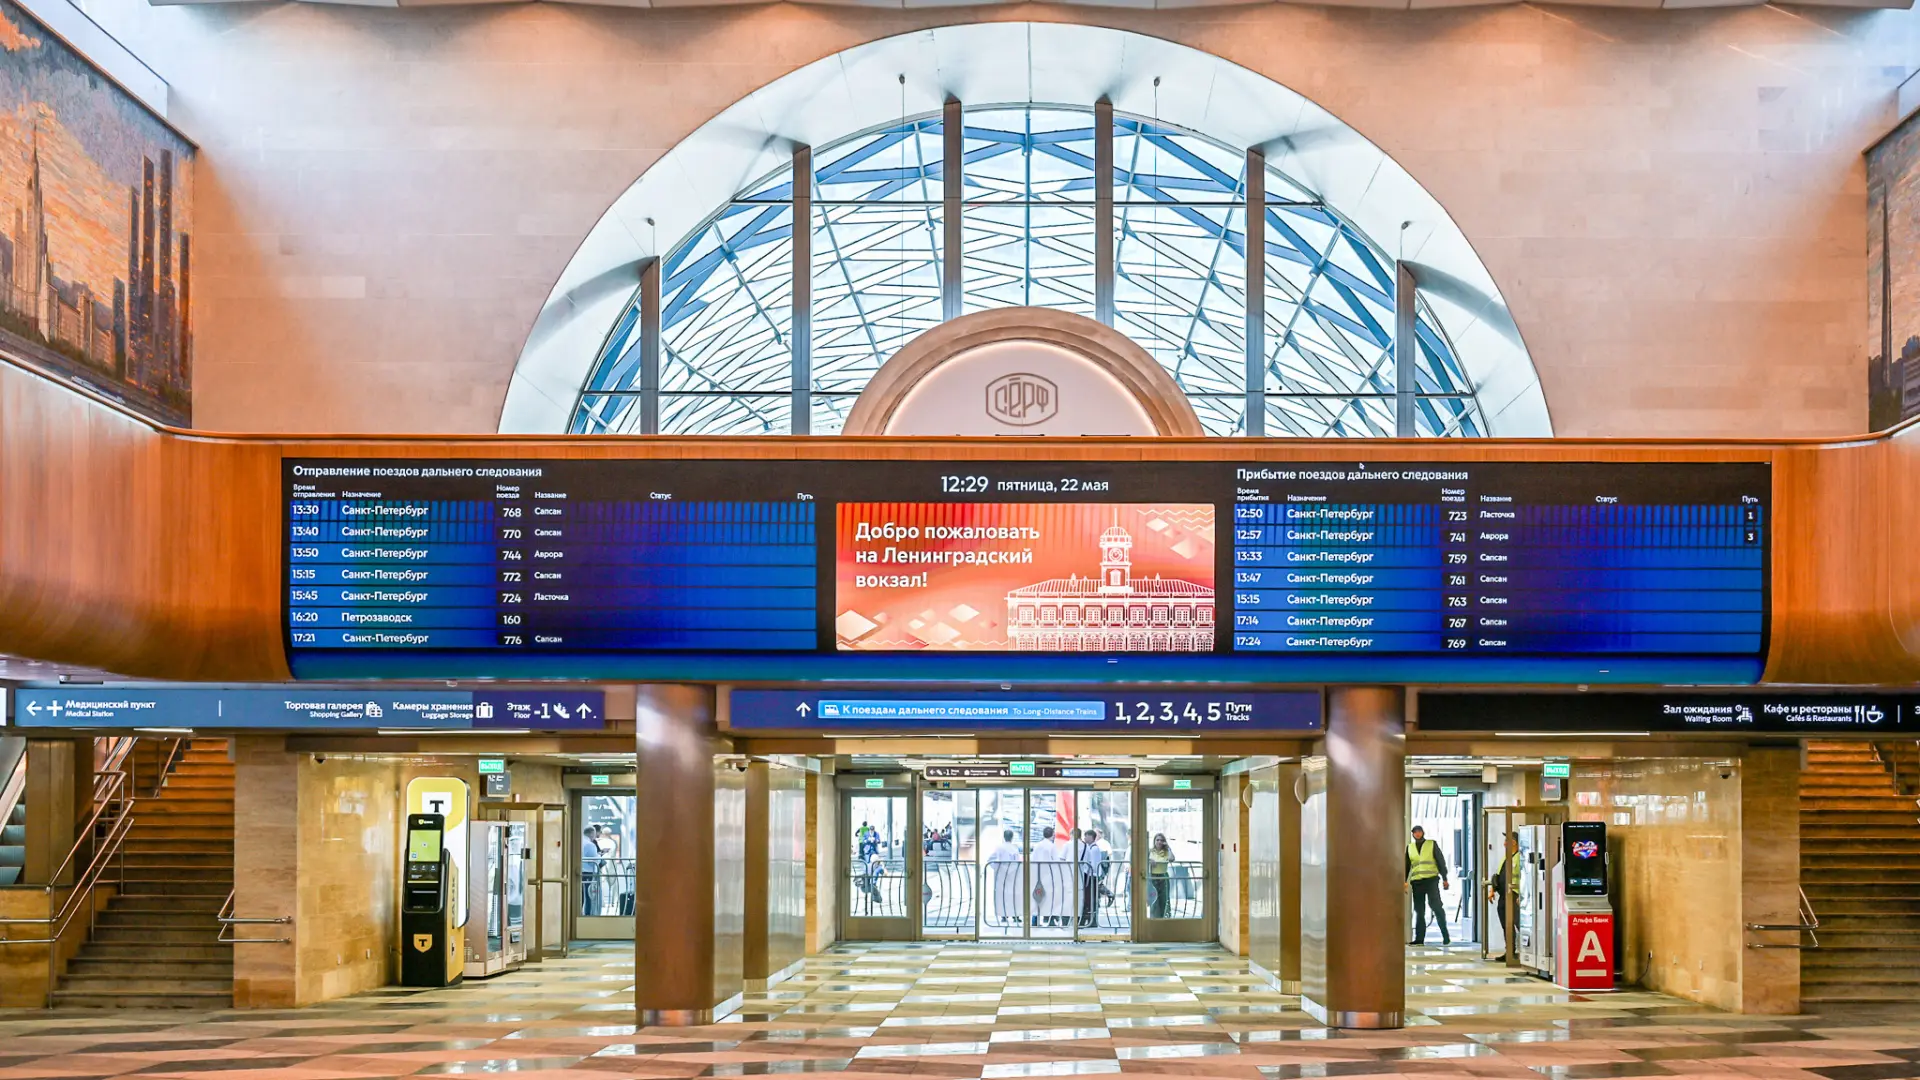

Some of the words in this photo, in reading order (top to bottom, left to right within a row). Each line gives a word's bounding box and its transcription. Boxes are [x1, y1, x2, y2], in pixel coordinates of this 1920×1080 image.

[293, 466, 371, 477] Отправление
[373, 467, 420, 477] поездов
[421, 467, 473, 477] дальнего
[475, 468, 542, 477] следования
[1237, 469, 1296, 481] Прибытие
[1299, 470, 1345, 481] поездов
[1347, 470, 1400, 481] дальнего
[1402, 471, 1468, 481] следования
[941, 476, 988, 493] 12:29
[998, 479, 1057, 493] пятница,
[1061, 479, 1078, 491] 22
[1082, 480, 1109, 491] мая
[293, 505, 319, 515] 13:30
[342, 505, 428, 516] Санкт-Петербург
[503, 508, 522, 518] 768
[1237, 509, 1263, 518] 12:50
[1287, 509, 1374, 520] Санкт-Петербург
[1449, 511, 1467, 521] 723
[293, 527, 319, 536] 13:40
[342, 527, 428, 538] Санкт-Петербург
[503, 529, 522, 539] 770
[855, 523, 919, 542] Добро
[925, 524, 1040, 540] пожаловать
[1237, 530, 1261, 540] 12:57
[1287, 530, 1374, 542] Санкт-Петербург
[1450, 533, 1466, 542] 741
[293, 548, 319, 558] 13:50
[342, 548, 428, 559] Санкт-Петербург
[502, 551, 522, 560] 744
[534, 551, 563, 559] Аврора
[856, 550, 878, 563] на
[882, 546, 1032, 566] Ленинградский
[1237, 551, 1262, 561] 13:33
[1287, 551, 1374, 563] Санкт-Петербург
[1448, 554, 1467, 564] 759
[1480, 554, 1507, 562] Сапсан
[293, 570, 315, 579] 15:15
[342, 570, 428, 581] Санкт-Петербург
[503, 572, 521, 582] 772
[534, 572, 561, 580] Сапсан
[856, 573, 927, 588] вокзал!
[1237, 573, 1261, 582] 13:47
[1287, 573, 1374, 584] Санкт-Петербург
[1450, 576, 1466, 585] 761
[293, 591, 318, 600] 15:45
[342, 591, 428, 602] Санкт-Петербург
[502, 593, 522, 603] 724
[1237, 594, 1260, 604] 15:15
[1287, 594, 1374, 606] Санкт-Петербург
[1448, 597, 1467, 606] 763
[1480, 597, 1507, 605] Сапсан
[293, 612, 318, 622] 16:20
[342, 612, 412, 624] Петрозаводск
[503, 615, 521, 625] 160
[1237, 616, 1259, 625] 17:14
[1287, 616, 1374, 627] Санкт-Петербург
[1449, 618, 1466, 628] 767
[1480, 618, 1507, 626] Сапсан
[293, 633, 316, 642] 17:21
[343, 633, 428, 645] Санкт-Петербург
[504, 636, 522, 645] 776
[1236, 637, 1261, 646] 17:24
[1286, 636, 1373, 648] Санкт-Петербург
[1448, 639, 1466, 648] 769
[66, 700, 128, 709] Медицинский
[131, 701, 156, 709] пункт
[285, 701, 325, 711] Торговая
[393, 702, 429, 711] Камеры
[507, 702, 531, 711] Этаж
[843, 705, 850, 714] К
[899, 707, 945, 716] дальнего
[948, 707, 1008, 716] следования
[1226, 702, 1251, 713] Пути
[1664, 705, 1681, 713] Зал
[1764, 704, 1789, 714] Кафе
[1023, 708, 1074, 716] Long-Distance
[1116, 702, 1131, 724] 1,
[1136, 702, 1155, 724] 2,
[1160, 702, 1179, 724] 3,
[1183, 702, 1203, 724] 4,
[1207, 702, 1220, 720] 5
